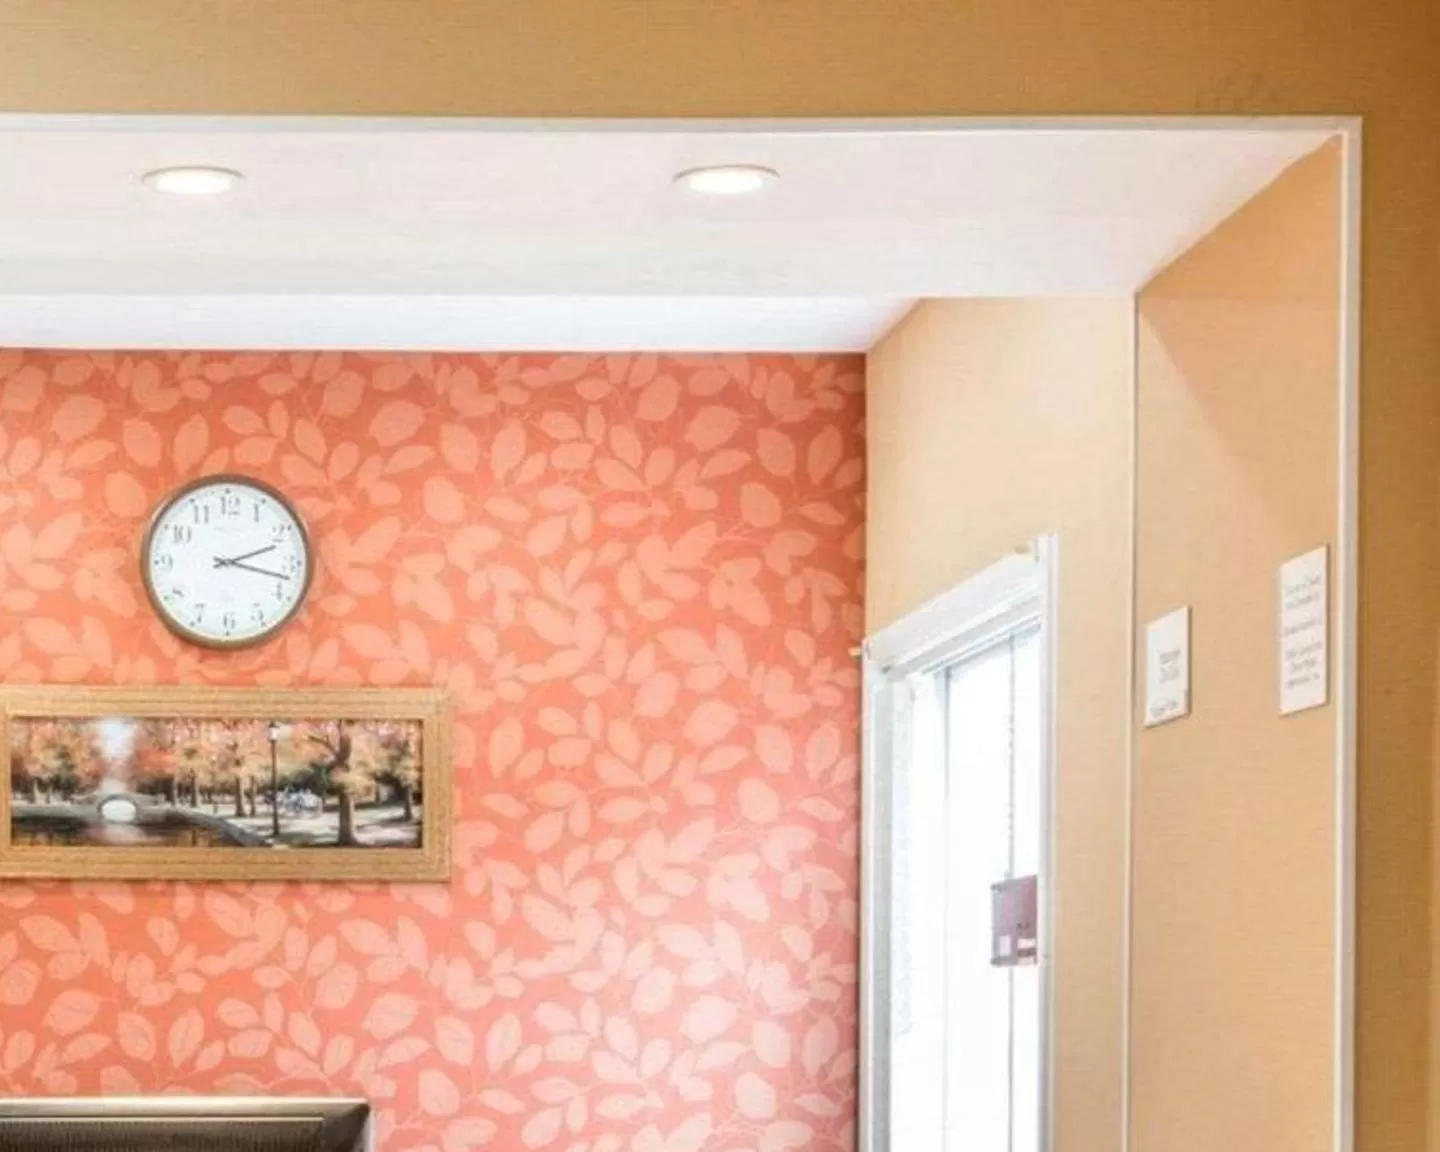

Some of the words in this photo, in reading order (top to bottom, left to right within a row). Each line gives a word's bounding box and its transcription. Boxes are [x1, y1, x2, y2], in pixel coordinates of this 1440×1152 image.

[193, 504, 210, 524] 11
[220, 496, 241, 516] 12
[254, 503, 260, 523] 1
[172, 523, 192, 544] 10
[272, 524, 286, 543] 2
[270, 582, 284, 602] 4
[194, 602, 206, 624] 7
